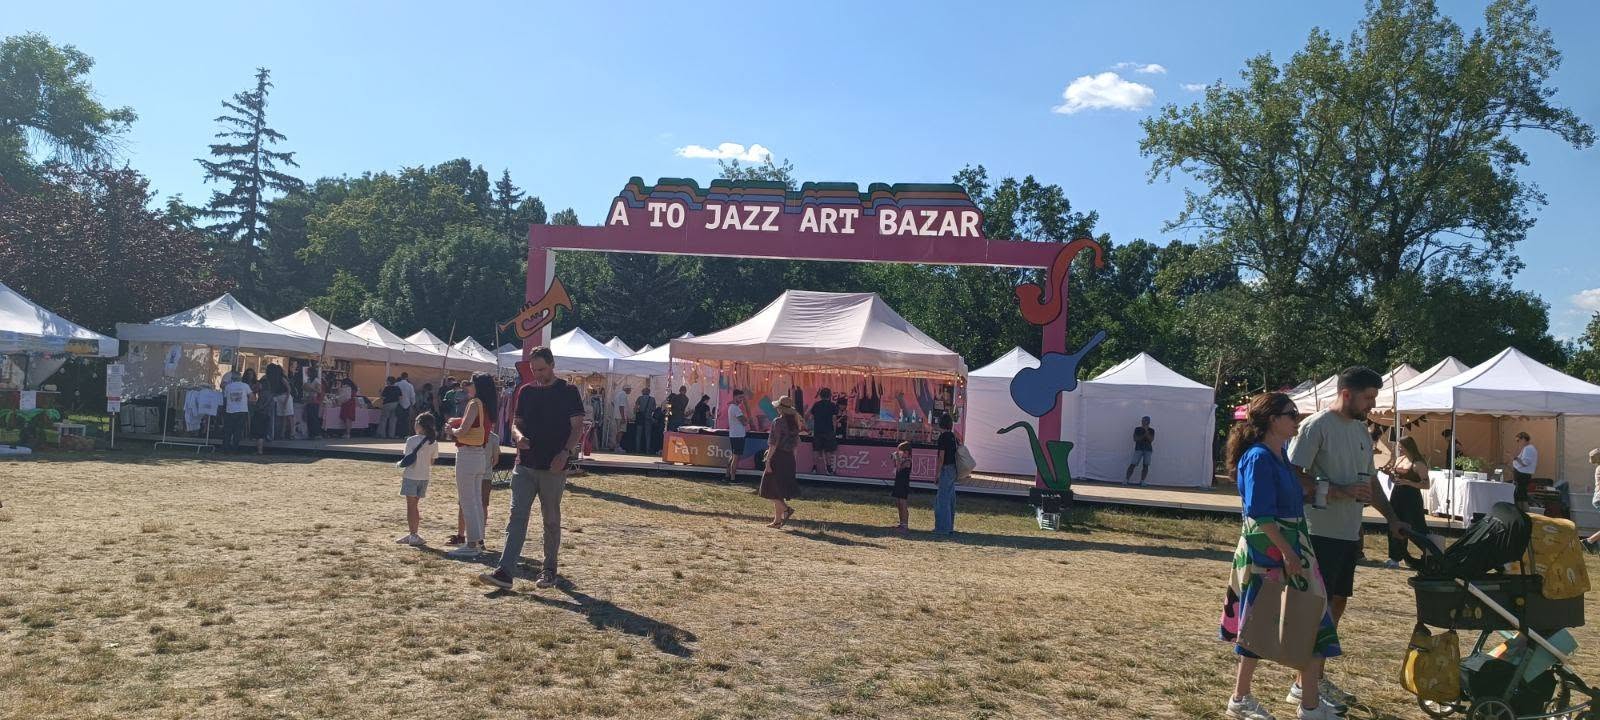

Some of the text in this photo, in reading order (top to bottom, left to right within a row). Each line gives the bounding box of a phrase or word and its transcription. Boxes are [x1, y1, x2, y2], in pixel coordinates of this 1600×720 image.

[610, 201, 980, 238] A TO JAZZ ART BAZAR
[674, 441, 732, 458] Fan Sho
